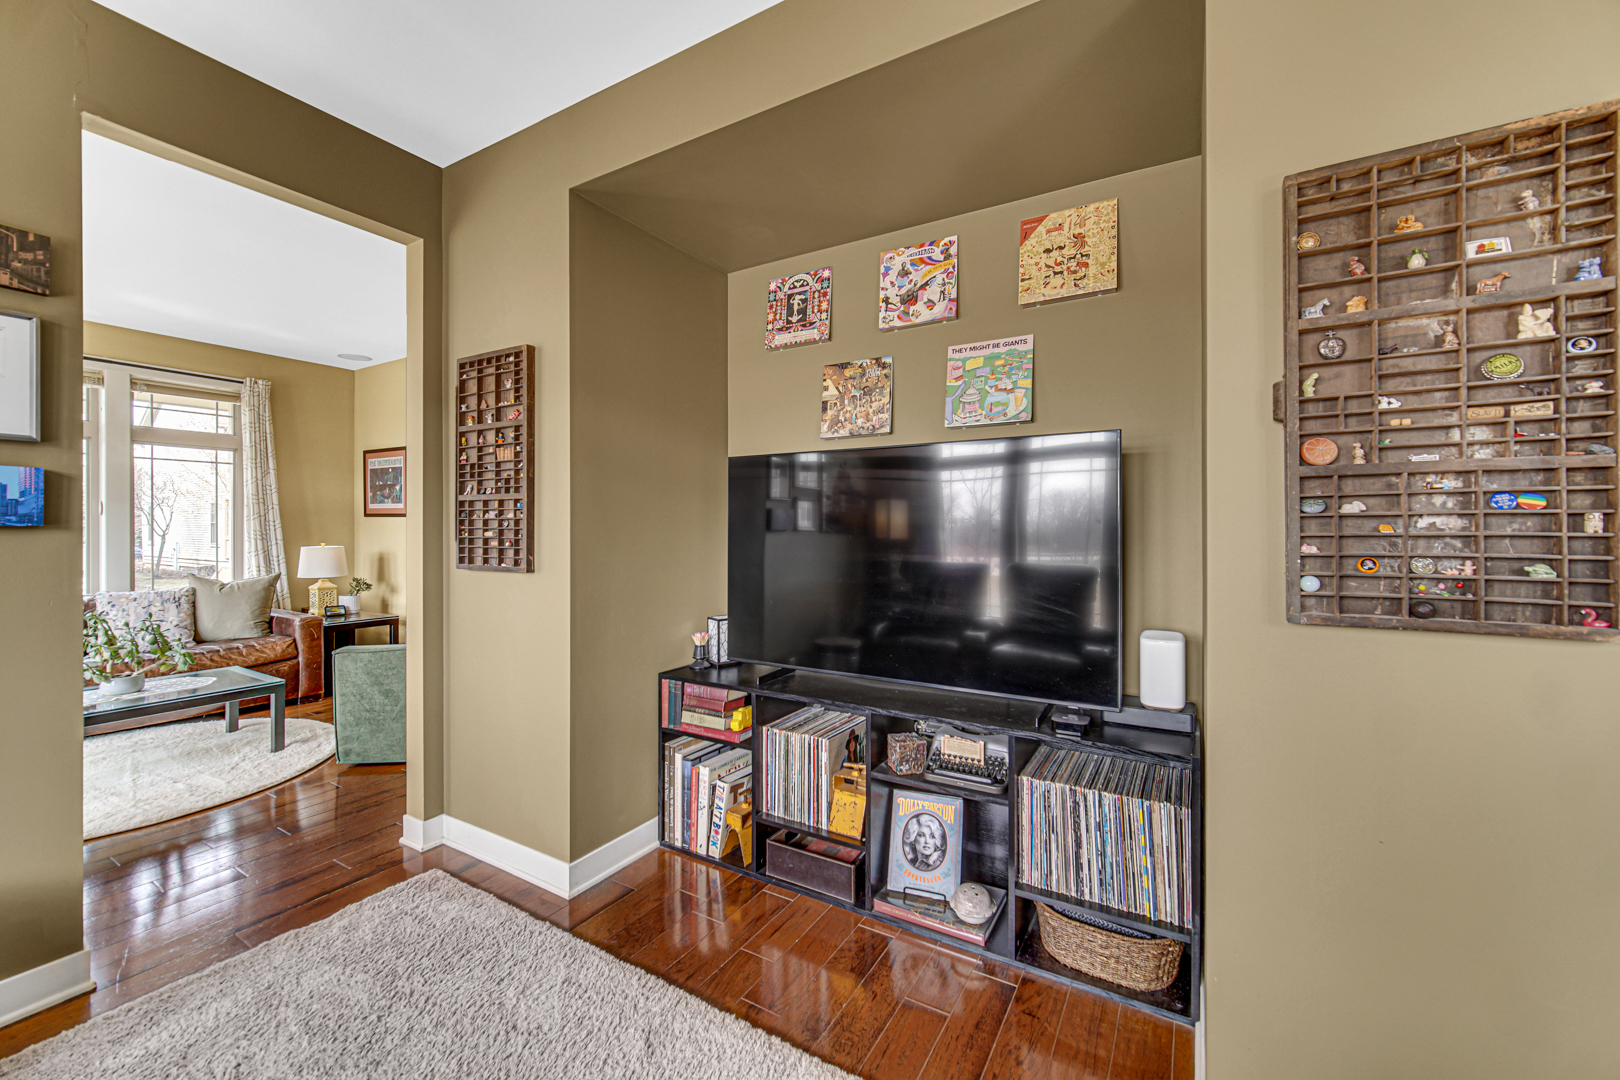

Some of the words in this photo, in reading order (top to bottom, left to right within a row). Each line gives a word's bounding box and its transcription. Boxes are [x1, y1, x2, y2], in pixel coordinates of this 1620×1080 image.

[969, 344, 990, 352] MIGHT
[1002, 338, 1028, 348] GIANTS
[1494, 360, 1515, 370] MILK
[716, 785, 725, 803] THE
[898, 797, 923, 816] DOLLY
[923, 802, 955, 824] PARTON
[710, 822, 721, 850] BOOK
